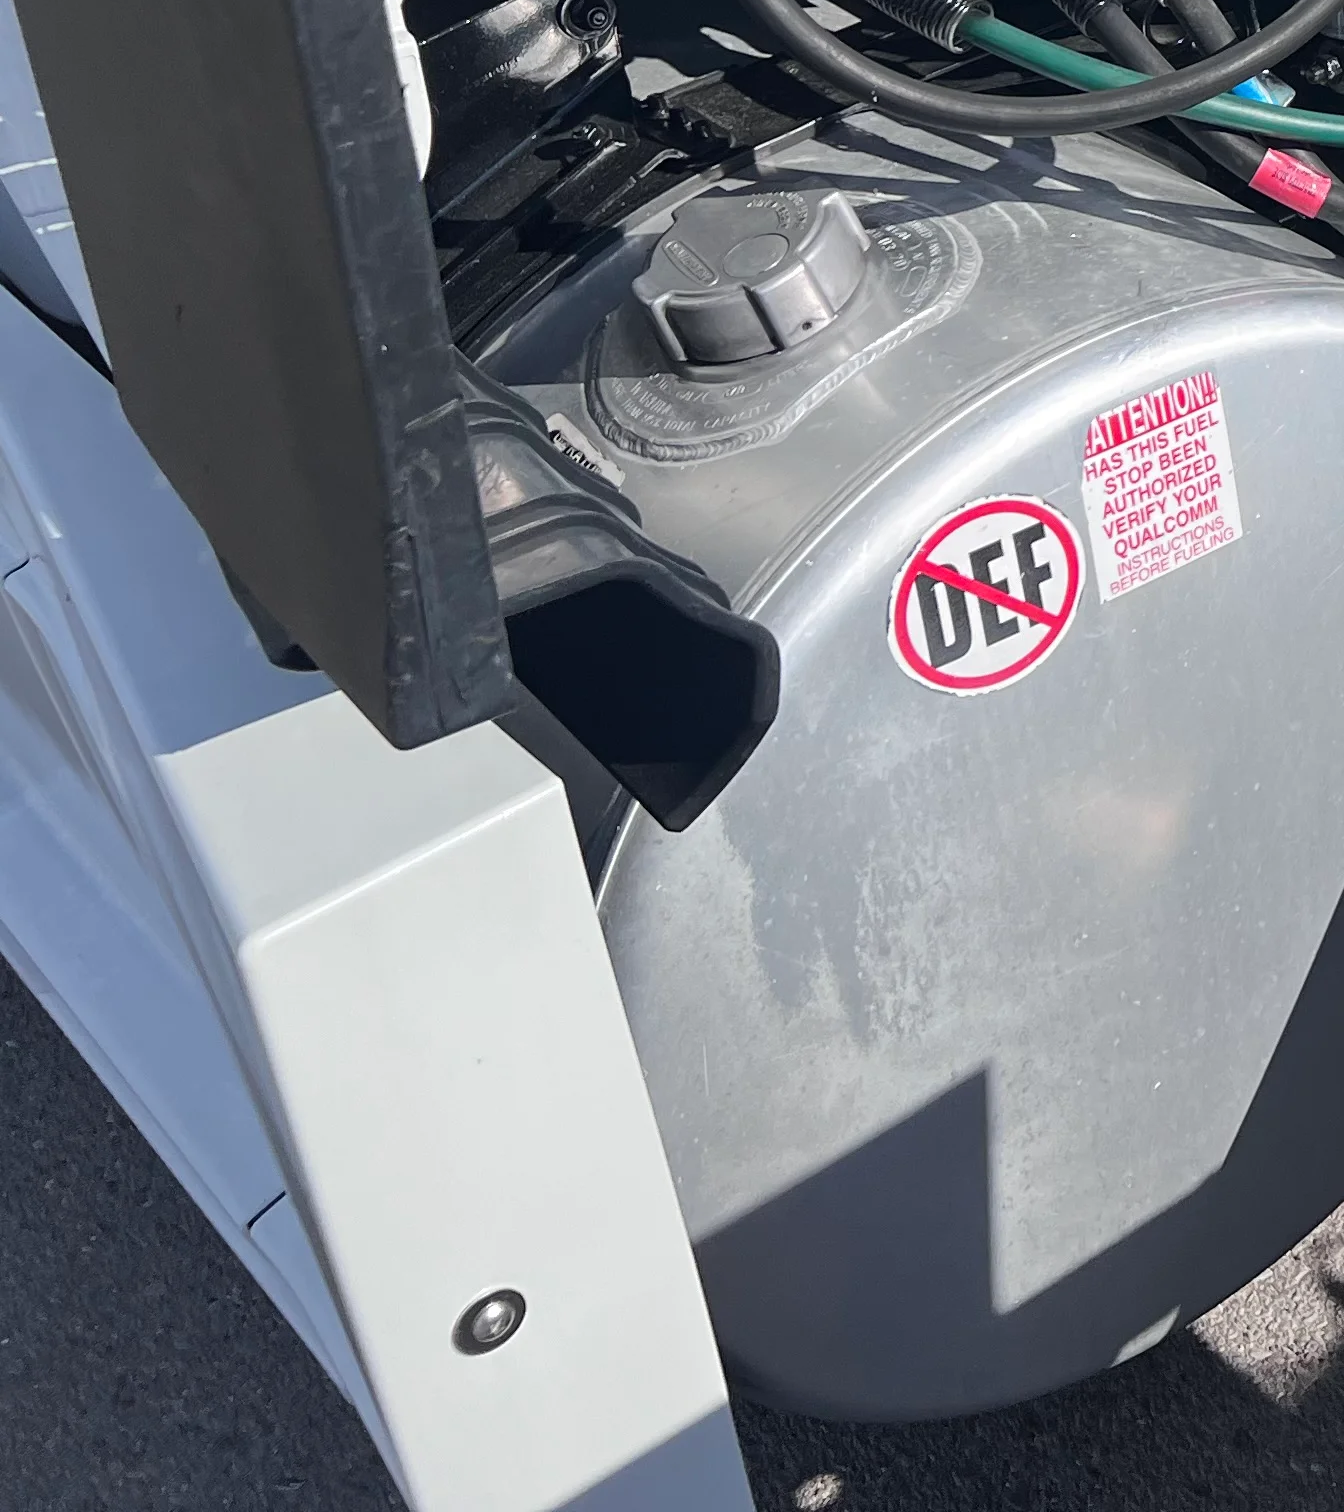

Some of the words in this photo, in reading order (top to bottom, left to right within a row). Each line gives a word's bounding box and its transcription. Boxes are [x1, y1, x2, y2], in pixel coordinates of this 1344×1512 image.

[1084, 452, 1124, 482] HAS
[1127, 431, 1169, 462] THIS
[1173, 410, 1219, 442] FUEL
[1104, 460, 1153, 495] STOP
[1158, 435, 1208, 471] BEEN
[1102, 453, 1217, 520] AUTHORIZED
[1102, 496, 1168, 539] VERIFY
[1172, 472, 1222, 507] YOUR
[1113, 494, 1219, 559] QUALCOMM
[1117, 515, 1225, 577] INSTRUCTIONS
[1109, 556, 1171, 595] BEFORE
[1173, 526, 1235, 565] FUELING
[914, 521, 1053, 669] DEF
